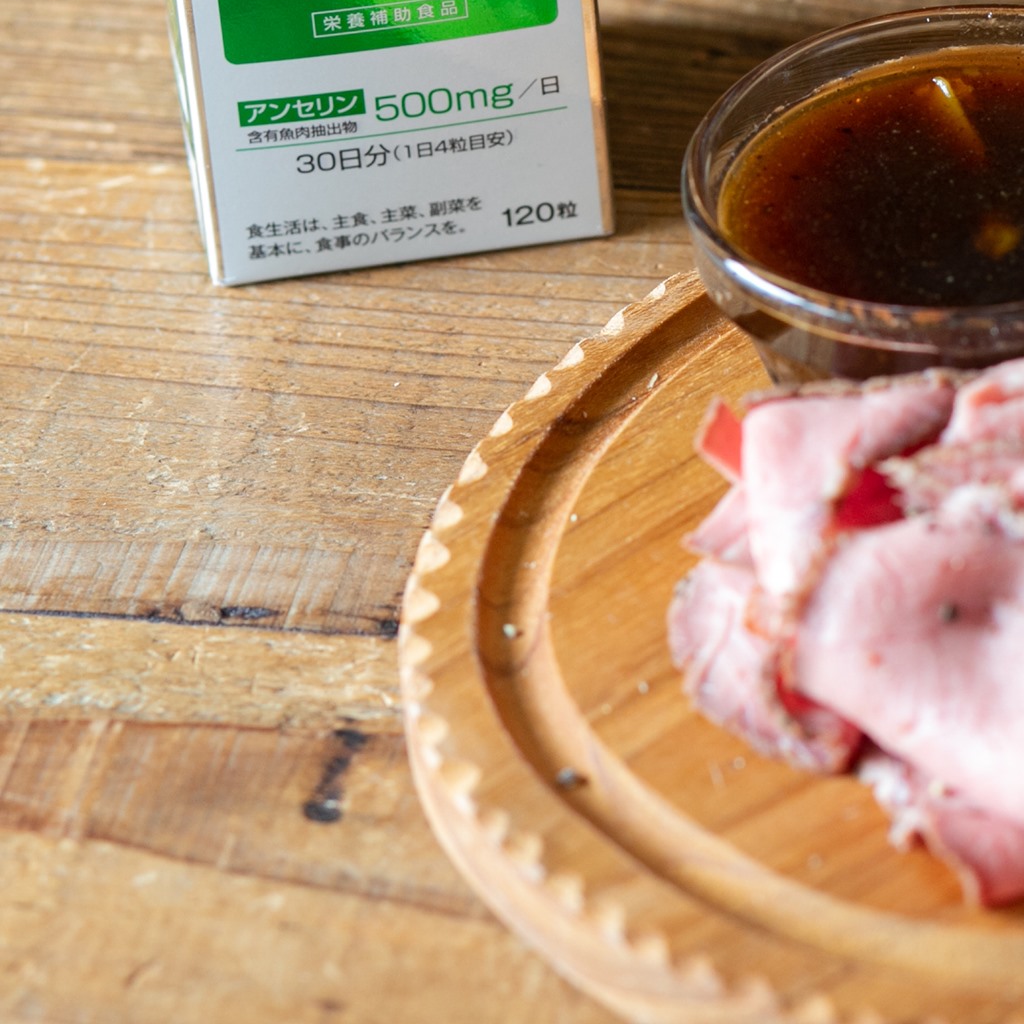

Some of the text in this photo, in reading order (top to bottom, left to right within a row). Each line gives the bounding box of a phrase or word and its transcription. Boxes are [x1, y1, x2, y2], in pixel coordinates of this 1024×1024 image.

[322, 0, 458, 31] 栄養補助食品
[244, 94, 359, 124] アンセリン
[247, 121, 359, 145] 含有魚肉抽出物
[502, 200, 578, 228] 120粒
